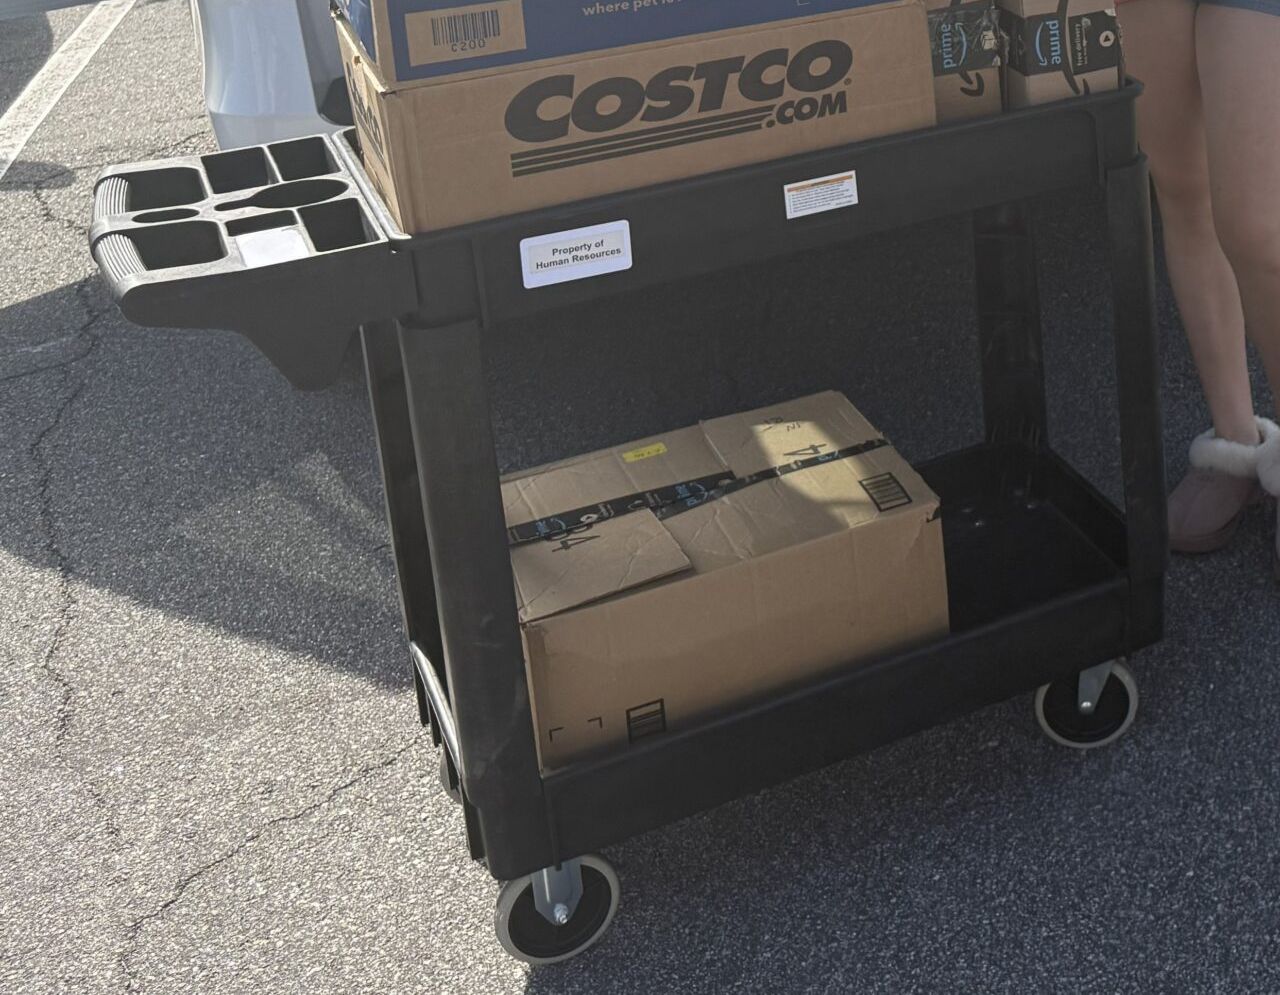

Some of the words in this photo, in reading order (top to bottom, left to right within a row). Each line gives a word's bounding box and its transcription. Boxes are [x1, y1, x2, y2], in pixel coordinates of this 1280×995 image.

[582, 0, 630, 16] where
[451, 38, 486, 53] C200
[941, 23, 957, 69] prime
[1046, 20, 1062, 65] prime
[504, 39, 854, 143] COSTCO
[765, 90, 848, 129] .COM
[536, 257, 570, 270] Human
[572, 248, 622, 263] Resources
[552, 242, 592, 257] Property
[595, 239, 604, 247] of
